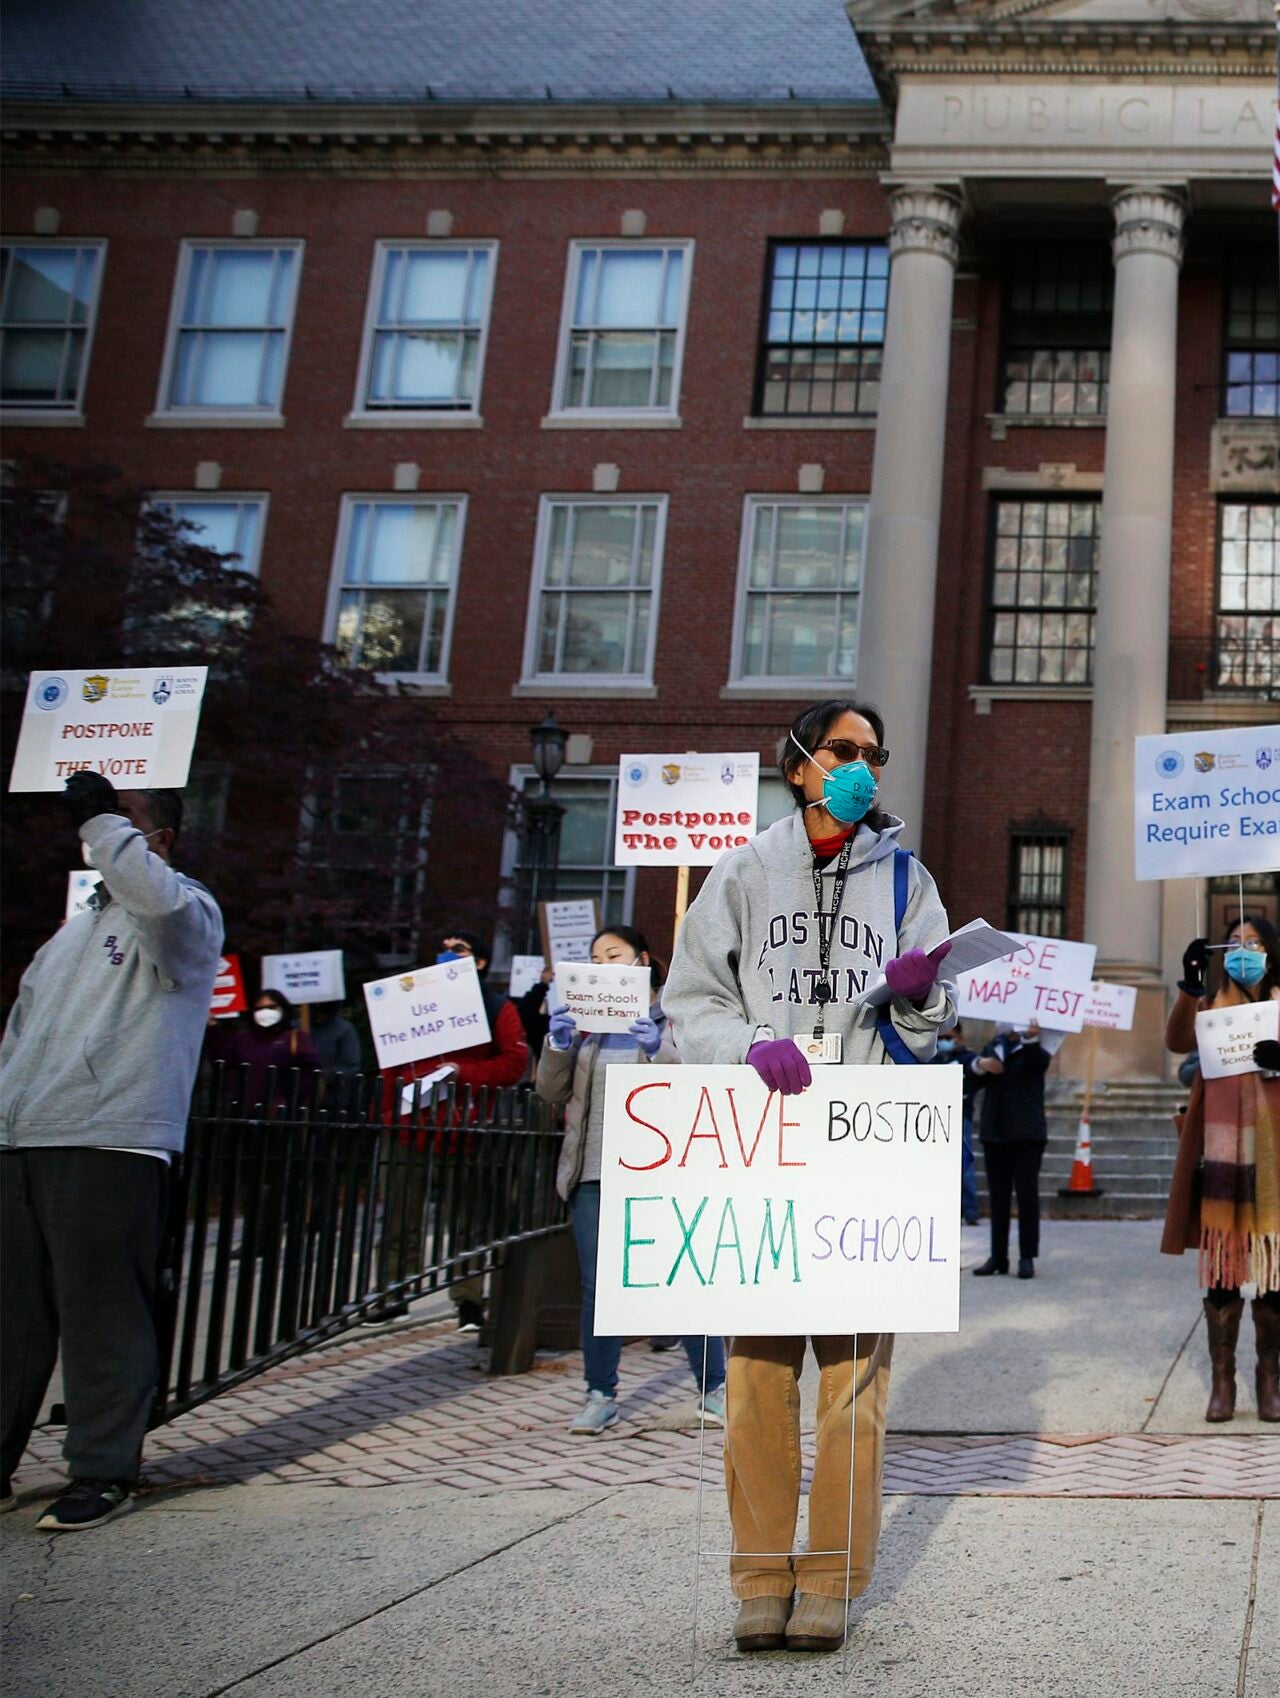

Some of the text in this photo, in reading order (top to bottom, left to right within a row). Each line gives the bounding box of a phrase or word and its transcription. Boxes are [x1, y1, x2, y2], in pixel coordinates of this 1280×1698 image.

[940, 96, 1152, 136] PUBLIC
[62, 722, 153, 739] POSTPONE
[98, 758, 147, 776] VOTE
[1152, 792, 1211, 812] Exam
[622, 810, 752, 829] Postpone
[623, 833, 750, 850] The Vote
[1146, 820, 1230, 845] Require
[839, 841, 852, 870] MCPHS
[565, 990, 639, 1004] Exam Schools
[967, 978, 1085, 1017] MAP TEST
[411, 1002, 438, 1017] Use
[607, 1006, 641, 1018] Exams
[380, 1013, 479, 1046] The MAP Test
[618, 1082, 952, 1171] SAVE BOSTON
[622, 1196, 947, 1288] EXAM SCHOOL
